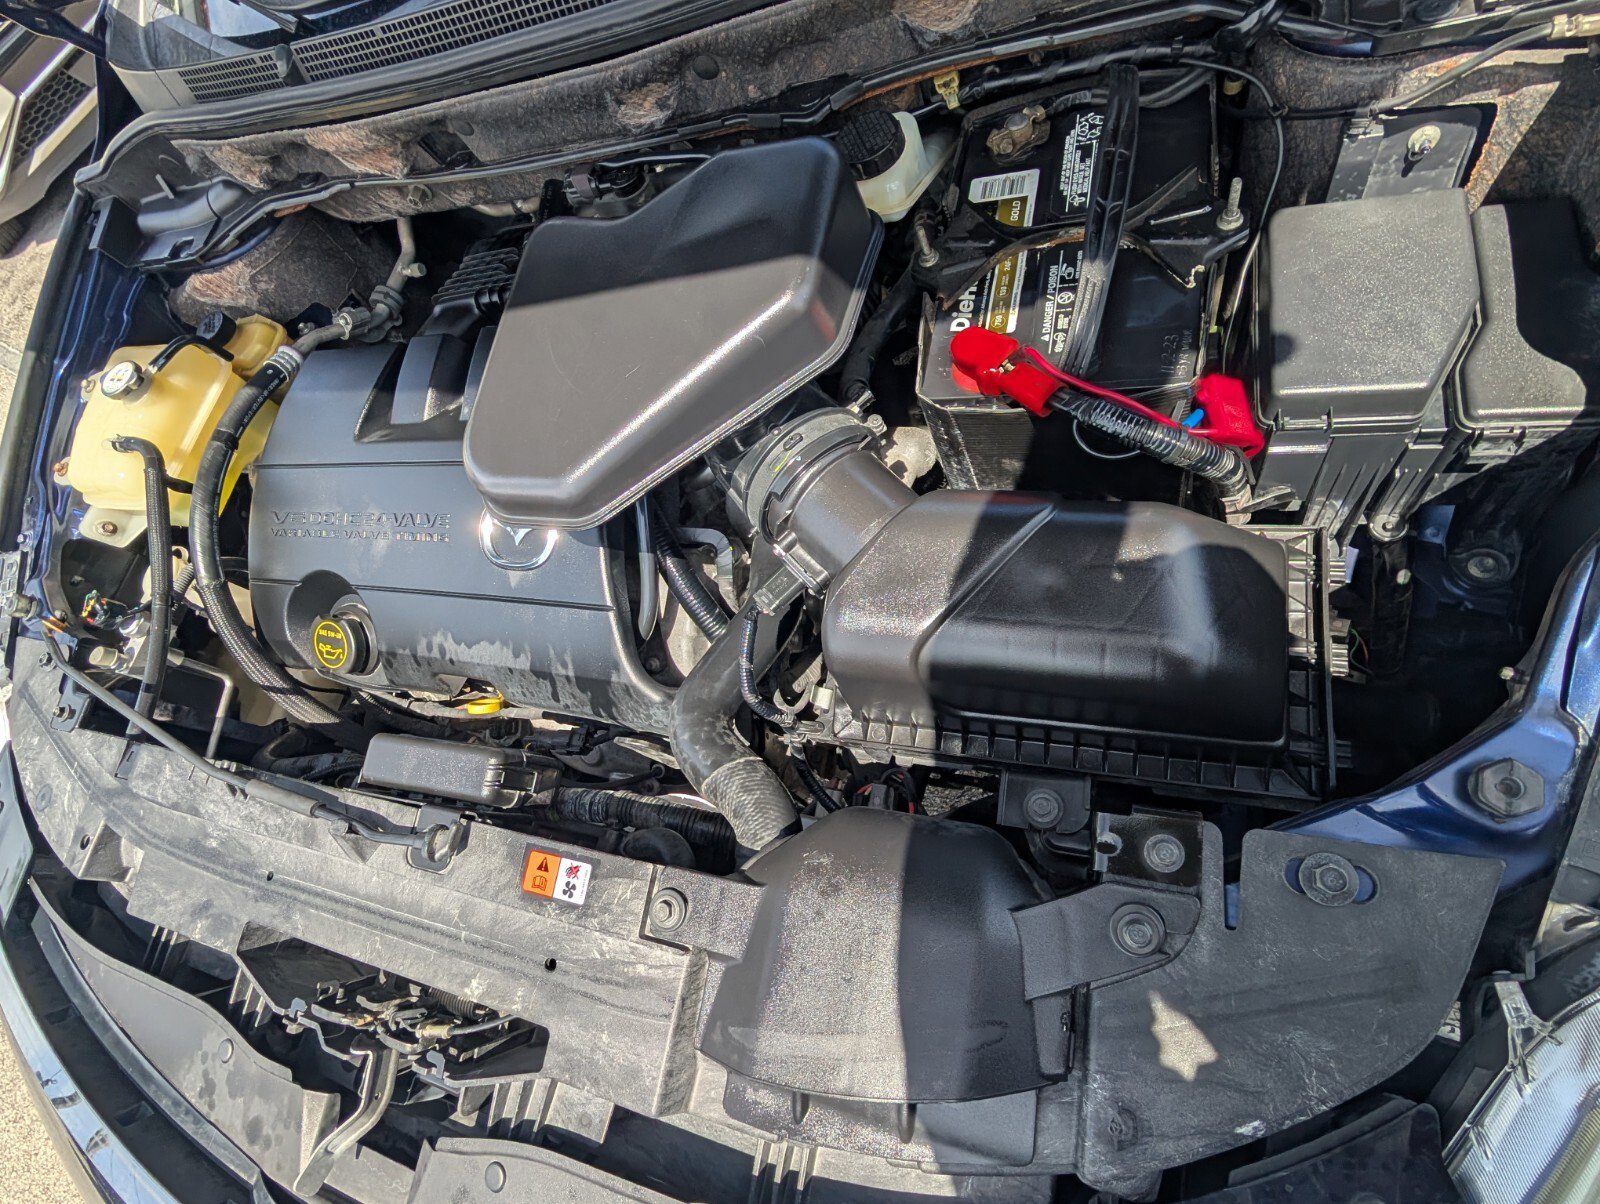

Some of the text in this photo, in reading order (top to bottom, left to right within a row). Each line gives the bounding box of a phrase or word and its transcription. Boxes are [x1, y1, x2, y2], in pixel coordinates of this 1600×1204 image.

[1010, 200, 1021, 221] GOLD
[1047, 265, 1059, 294] POISON
[950, 281, 979, 331] DieH
[1042, 301, 1054, 333] DANGER
[309, 512, 362, 526] DOHC
[363, 512, 451, 529] 24-VALVE
[271, 527, 450, 542] VARIABLE VALVE TIMING
